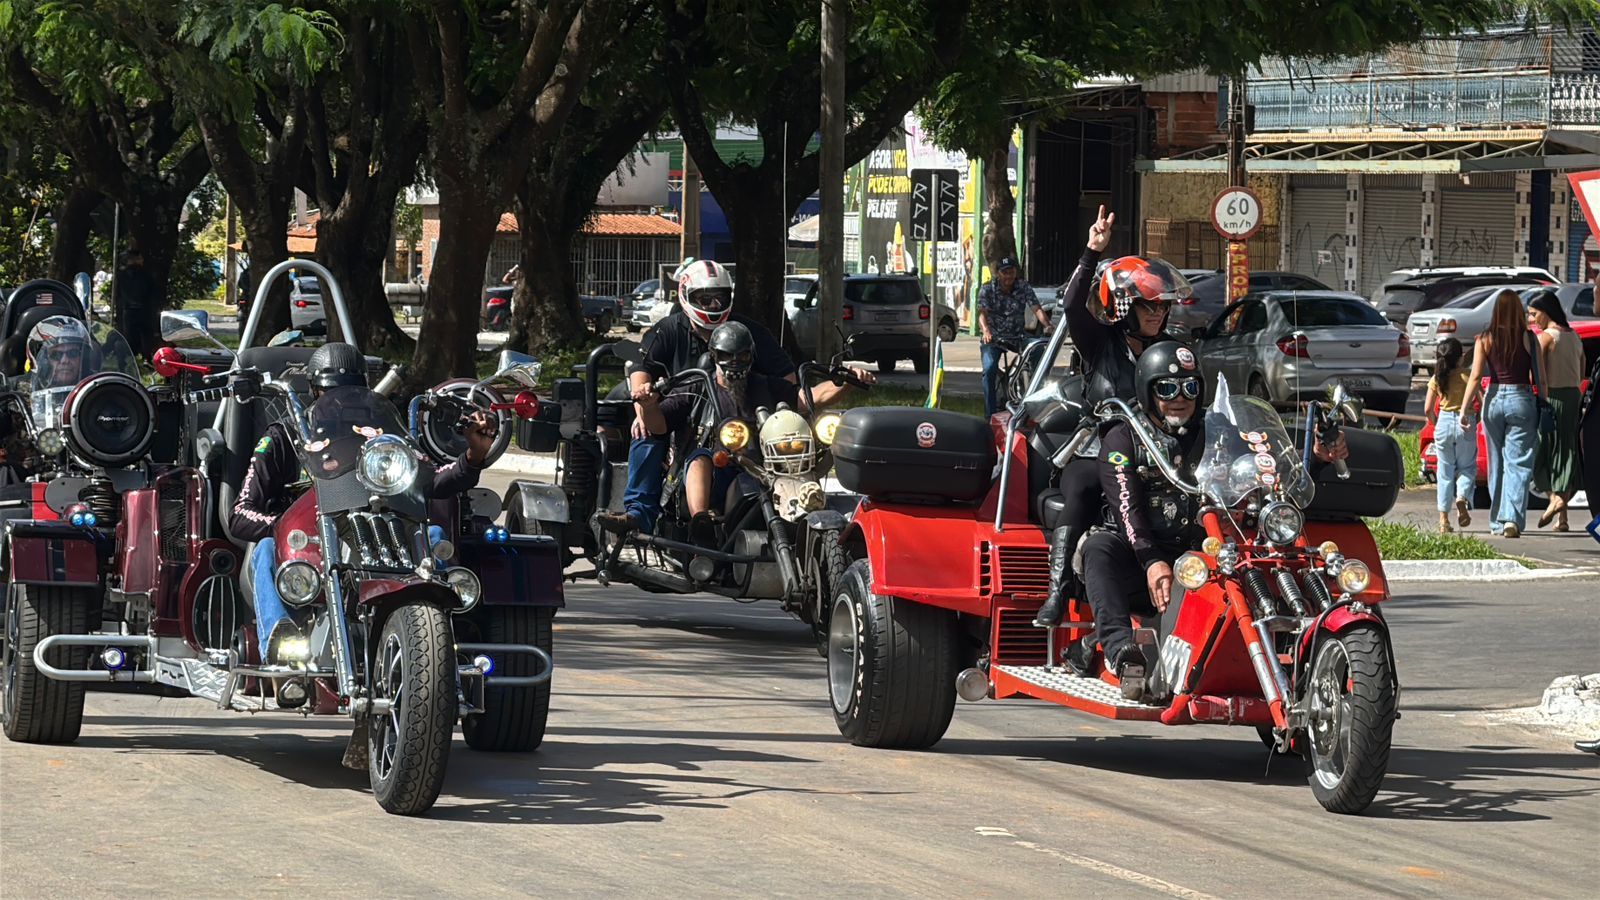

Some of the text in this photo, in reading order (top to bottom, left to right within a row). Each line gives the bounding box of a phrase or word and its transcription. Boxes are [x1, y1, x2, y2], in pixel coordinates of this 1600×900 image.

[893, 149, 907, 169] VOC
[1227, 198, 1249, 216] 60
[1224, 219, 1251, 230] km/h
[856, 602, 865, 704] GALAXY
